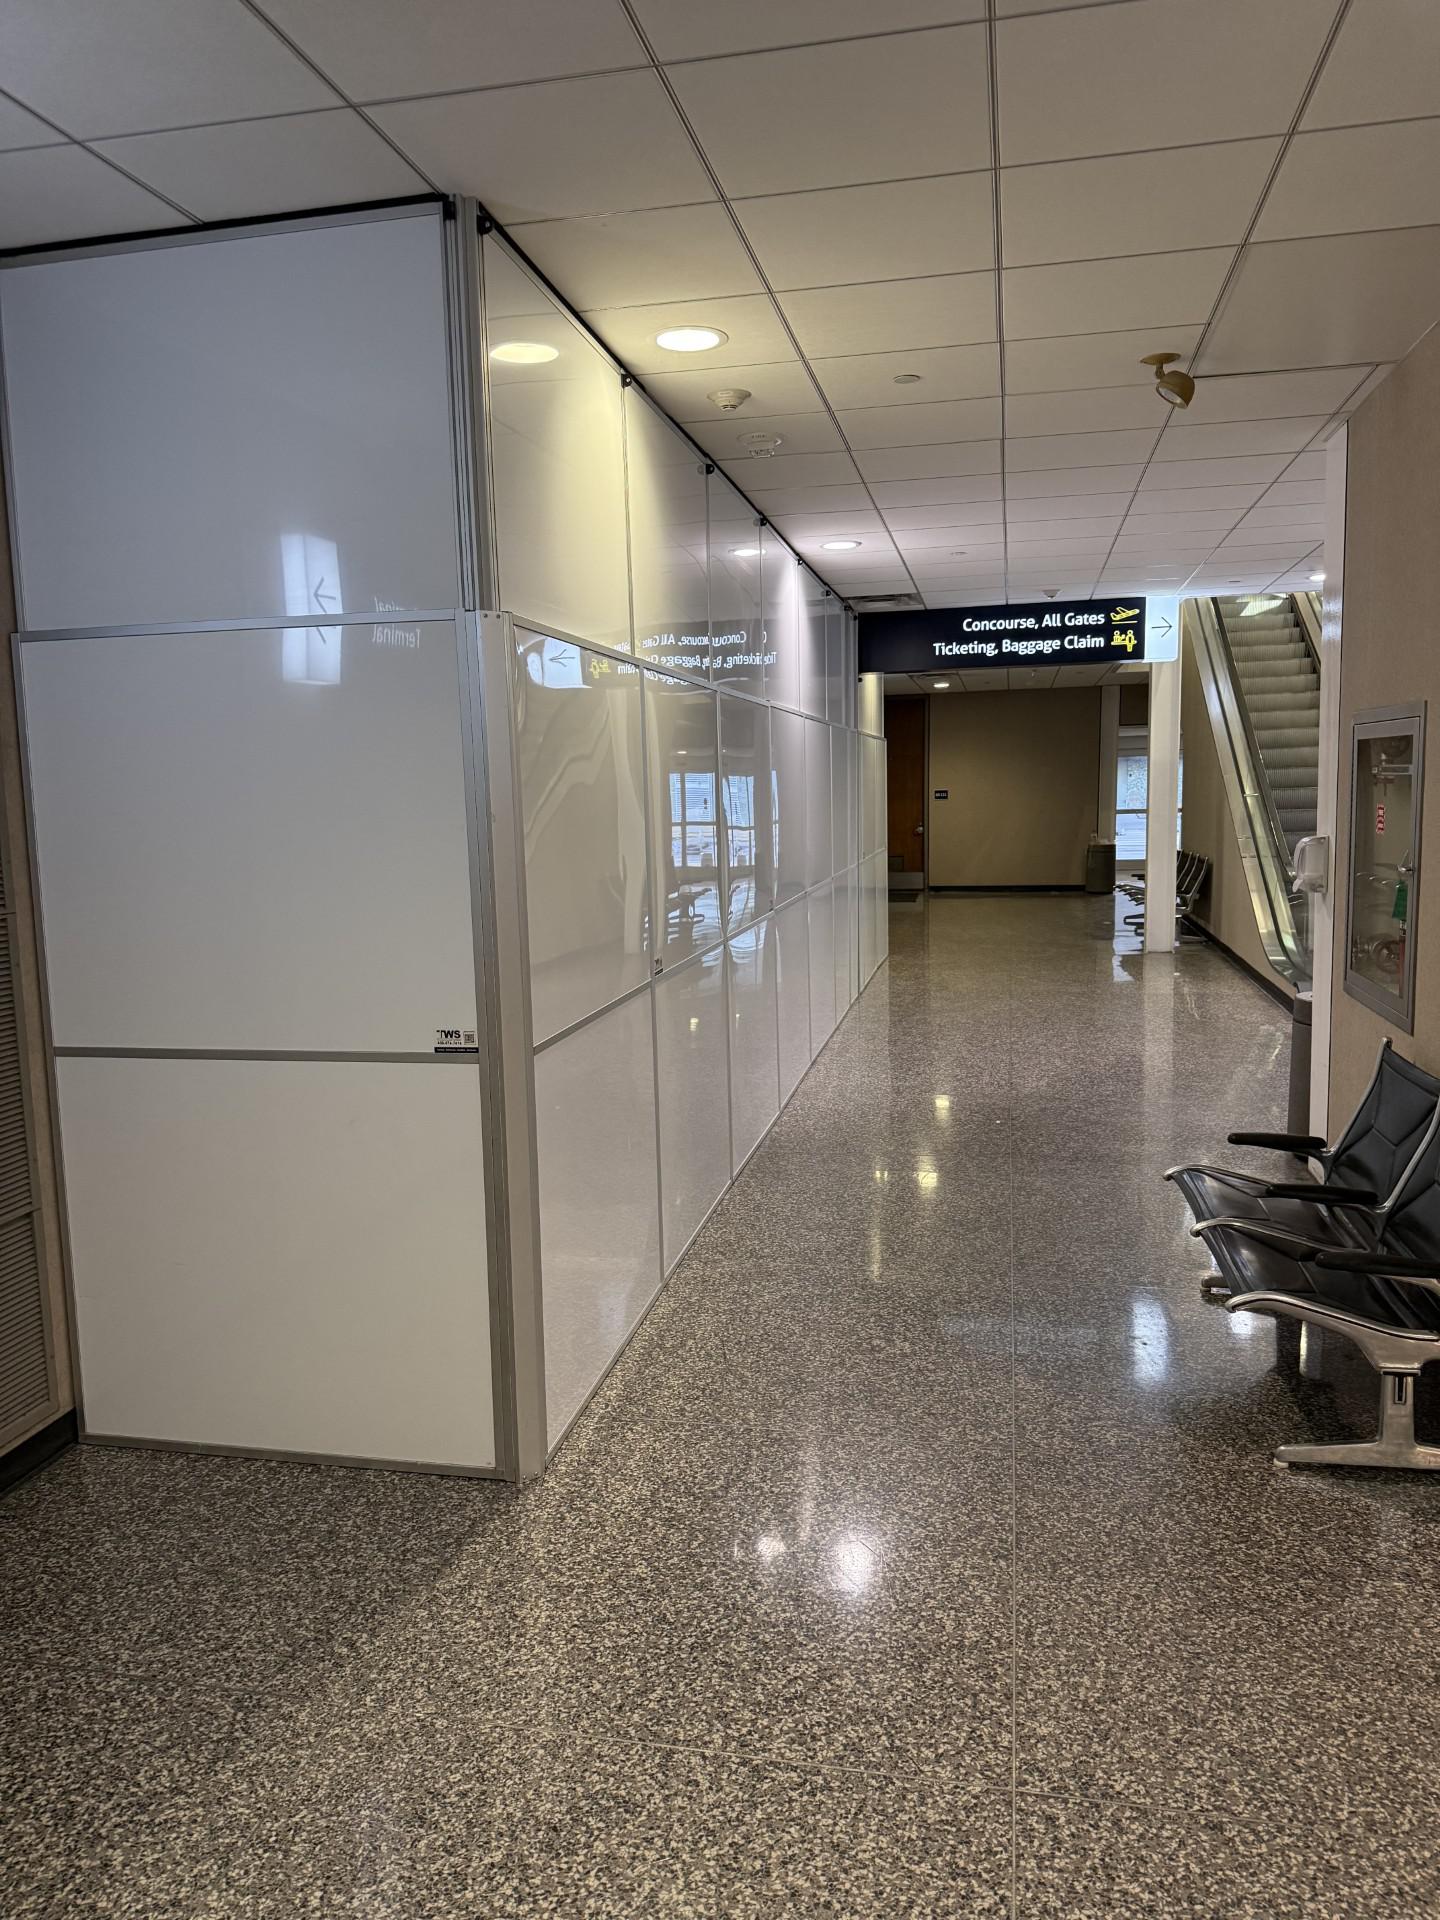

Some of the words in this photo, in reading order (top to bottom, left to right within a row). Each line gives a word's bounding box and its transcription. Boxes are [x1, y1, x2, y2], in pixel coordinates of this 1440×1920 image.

[962, 617, 1039, 632] Concourse,
[1041, 613, 1062, 628] All
[1064, 612, 1105, 626] Gates
[932, 640, 999, 657] Ticketing,
[1001, 638, 1061, 656] Baggage
[1063, 634, 1105, 649] Claim
